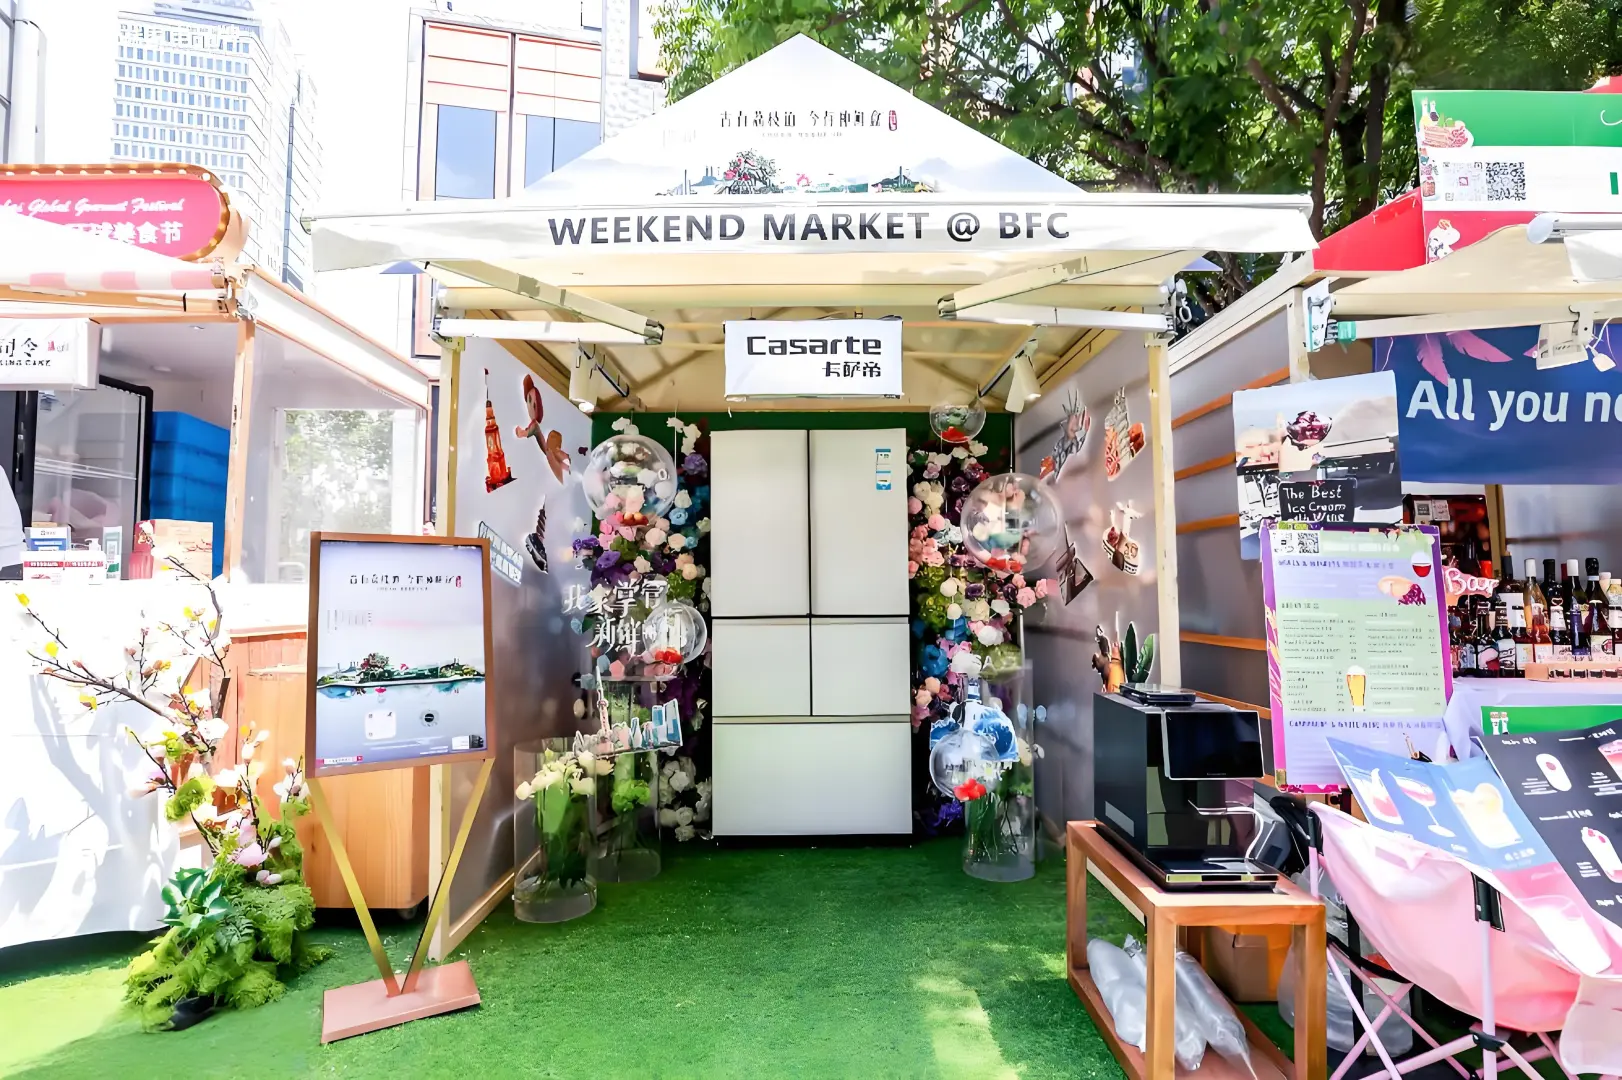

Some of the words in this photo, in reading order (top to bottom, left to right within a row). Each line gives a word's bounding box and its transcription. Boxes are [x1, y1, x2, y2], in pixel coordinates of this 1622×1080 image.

[131, 197, 185, 214] Festival
[548, 213, 745, 246] WEEKEND
[763, 211, 930, 241] MARKET
[946, 212, 981, 243] @
[998, 211, 1070, 240] BFC
[746, 336, 882, 355] Casarte
[821, 361, 882, 378] 卡萨帝
[1405, 378, 1475, 421] All
[1488, 390, 1569, 431] you
[1282, 487, 1305, 499] The
[1311, 484, 1342, 499] Best
[1287, 503, 1306, 513] Ice
[1444, 567, 1498, 595] Bar
